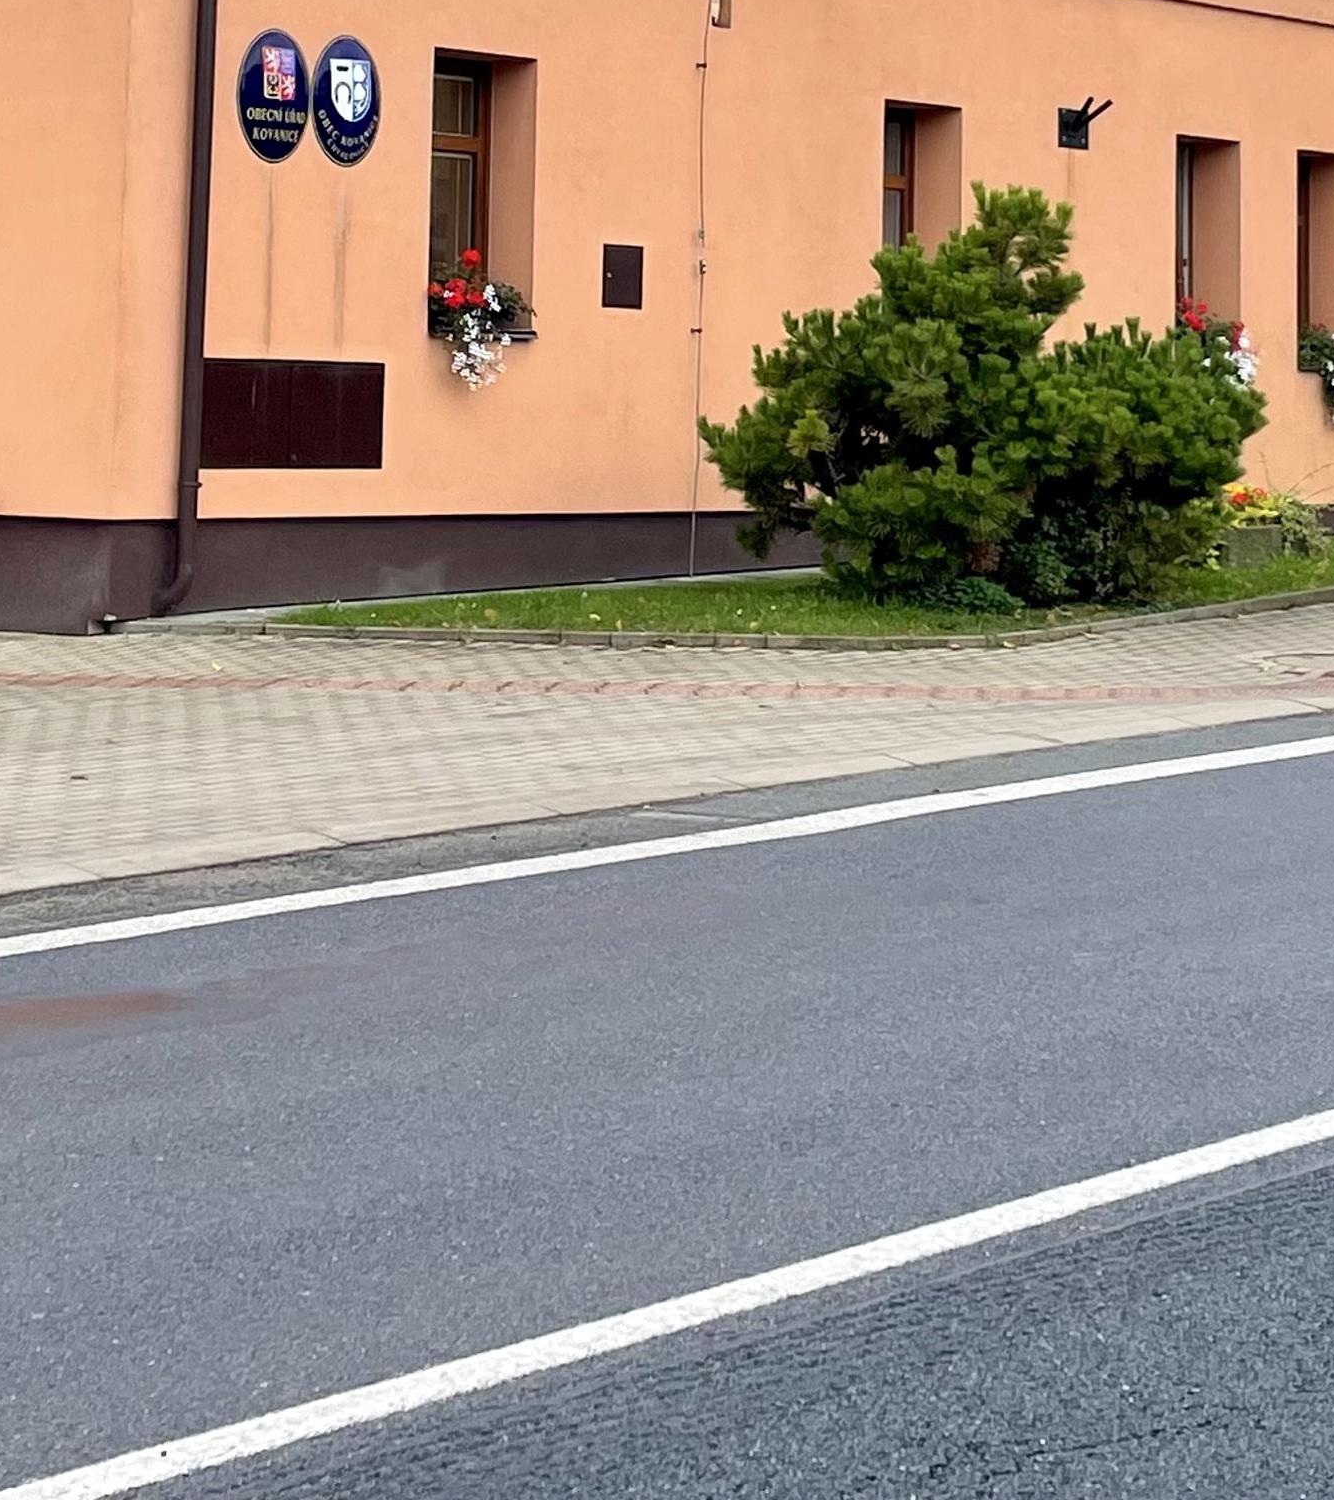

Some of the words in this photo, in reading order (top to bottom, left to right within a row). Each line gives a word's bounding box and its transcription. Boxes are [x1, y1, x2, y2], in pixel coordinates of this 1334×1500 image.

[246, 107, 283, 121] OBECNÍ
[318, 109, 340, 140] OBEC
[252, 126, 299, 143] KOVANICE
